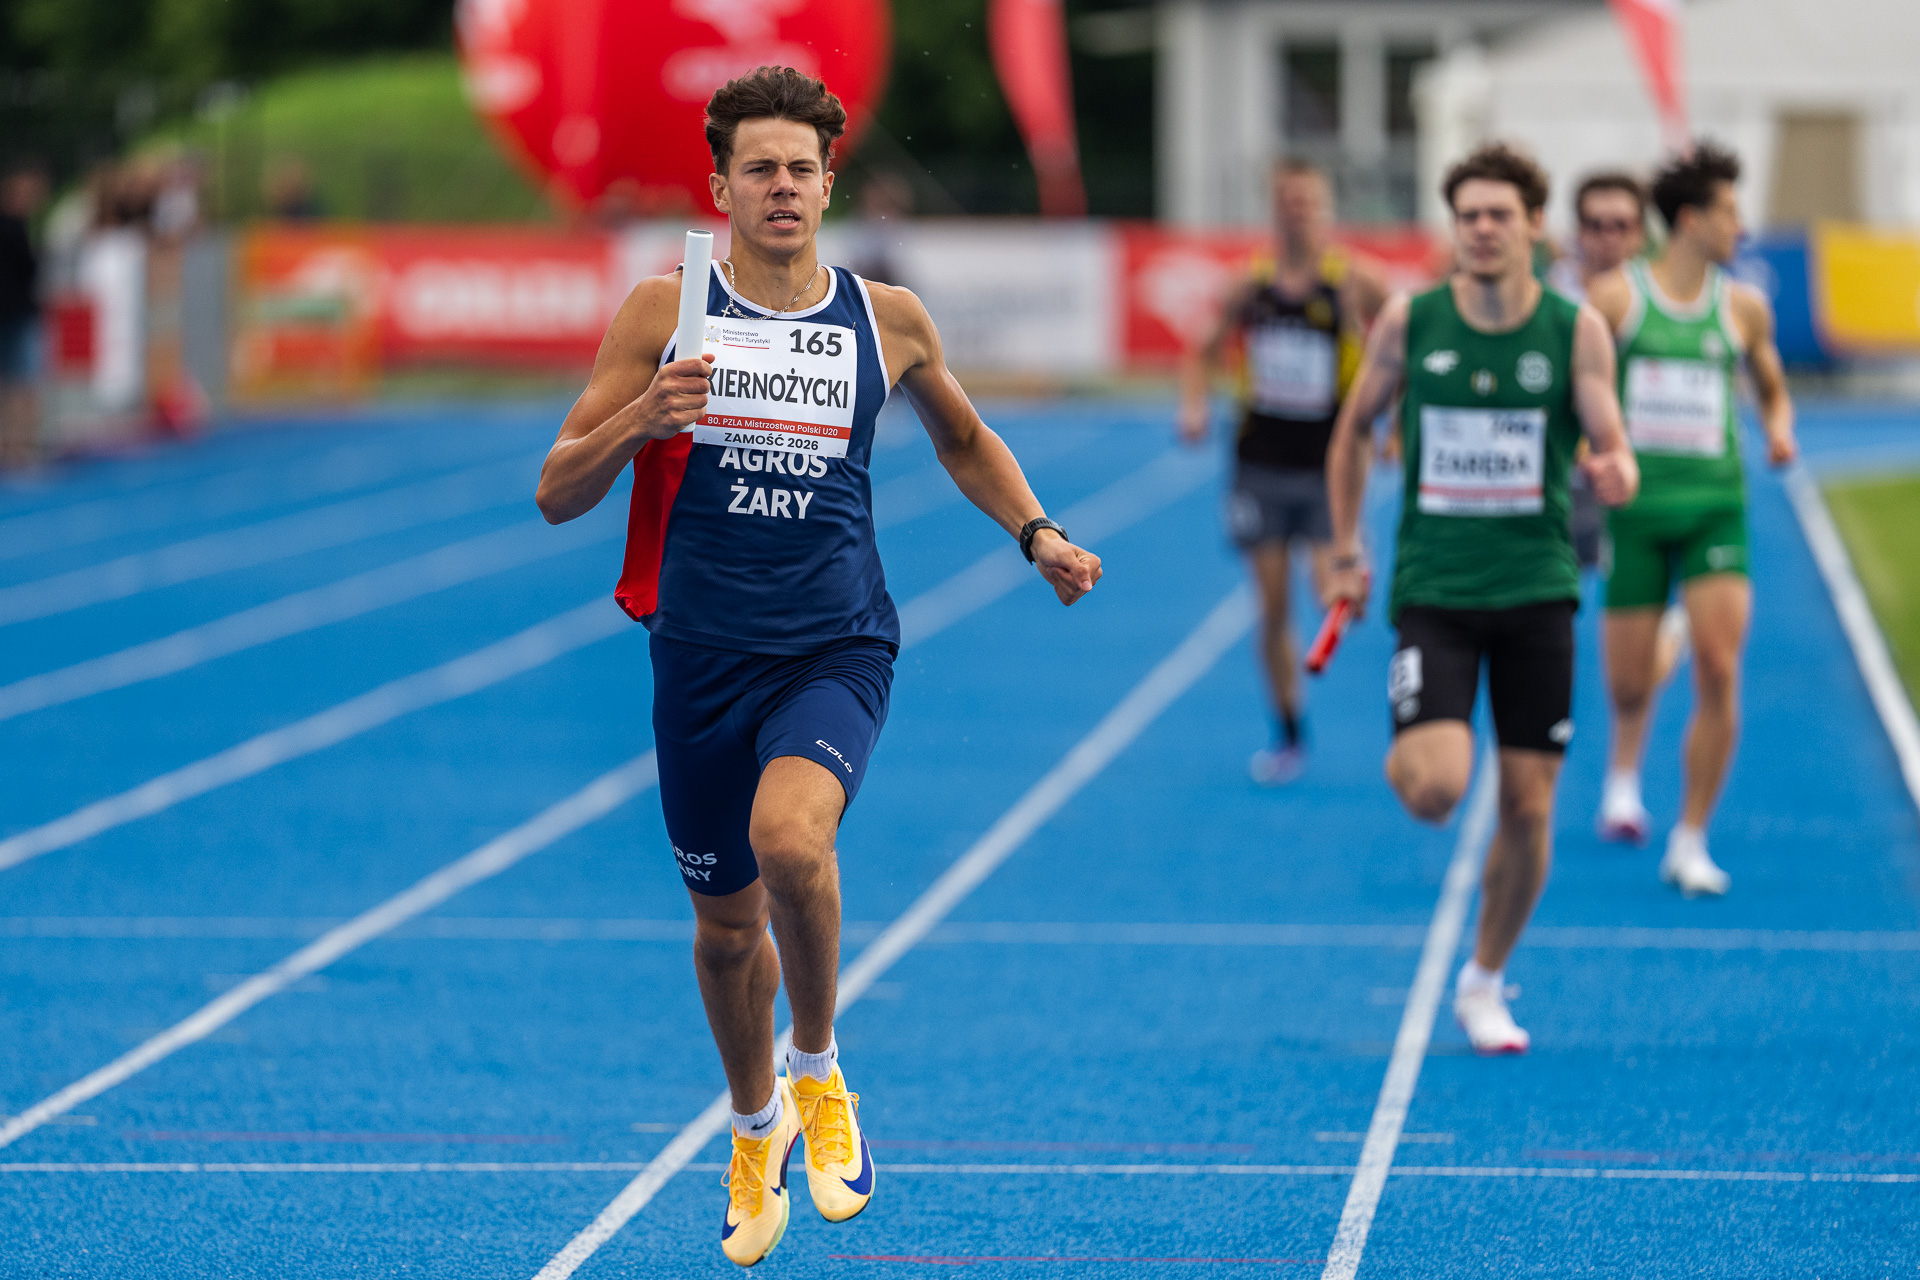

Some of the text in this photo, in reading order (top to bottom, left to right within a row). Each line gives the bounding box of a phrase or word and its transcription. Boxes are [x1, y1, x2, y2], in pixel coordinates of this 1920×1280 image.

[722, 329, 759, 337] Ministerstwo
[789, 329, 842, 357] 165
[707, 416, 839, 437] 80. PZLA Mistrzostwa Polski U20
[724, 432, 819, 451] ZAMOŚĆ 2026
[718, 446, 828, 479] AGROS
[727, 478, 814, 520] ŻARY
[670, 840, 718, 865] ROS
